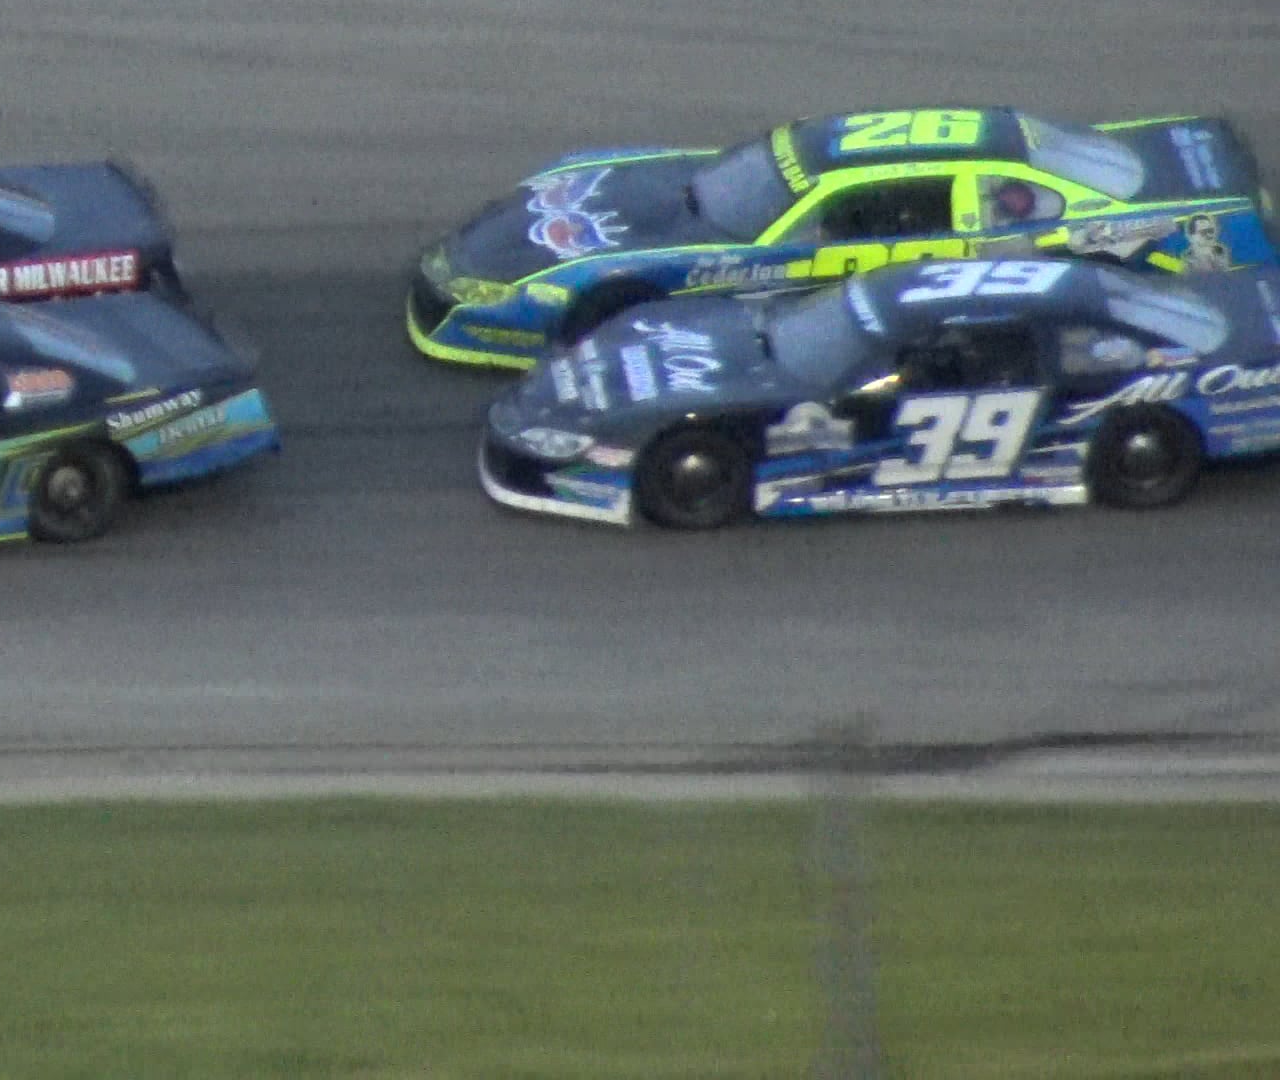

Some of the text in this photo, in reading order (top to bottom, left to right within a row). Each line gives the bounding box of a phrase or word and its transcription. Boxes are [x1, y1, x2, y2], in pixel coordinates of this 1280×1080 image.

[841, 110, 982, 151] 26
[13, 254, 134, 290] MILWAUKEE
[899, 260, 1072, 303] 39
[106, 388, 202, 430] Shumway
[1056, 371, 1189, 424] All
[873, 390, 1042, 487] 39
